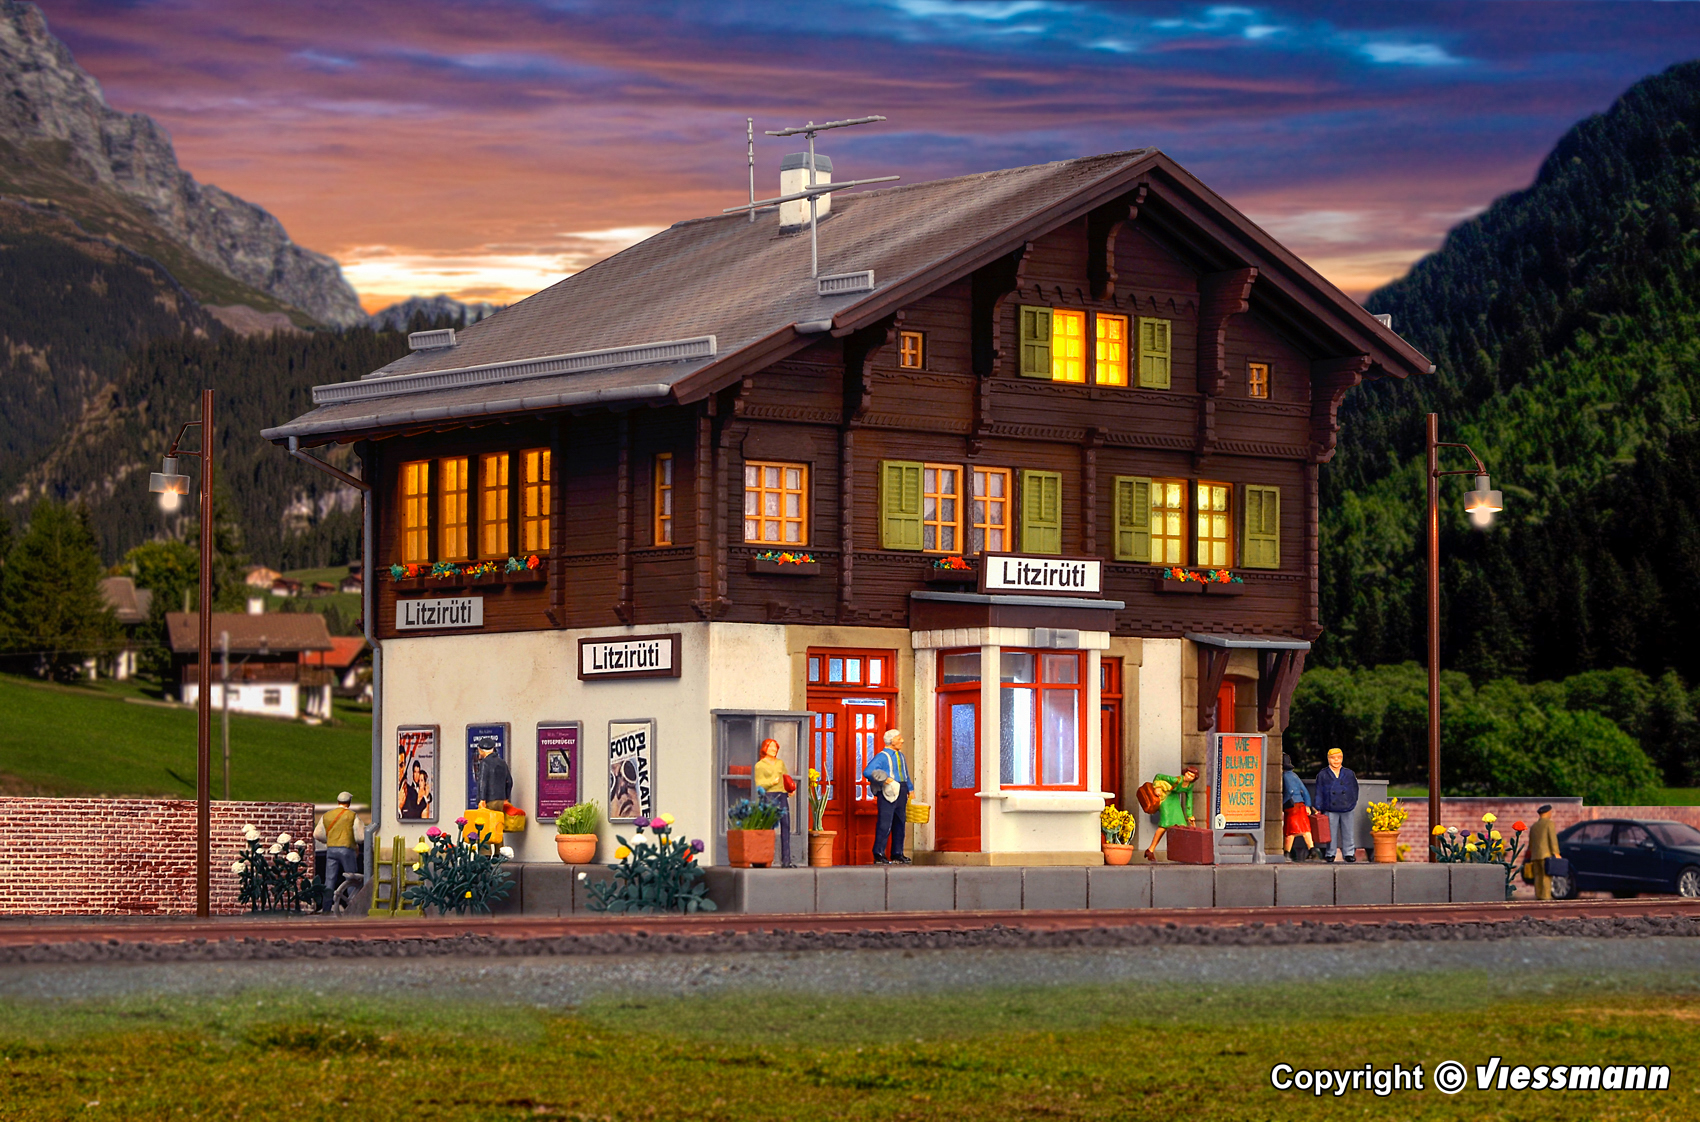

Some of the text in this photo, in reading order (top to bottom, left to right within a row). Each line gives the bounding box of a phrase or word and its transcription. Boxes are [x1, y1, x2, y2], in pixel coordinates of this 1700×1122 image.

[1003, 561, 1085, 587] Litzirüti
[405, 600, 472, 625] Litzirüti
[592, 643, 659, 670] Litzirüti
[611, 735, 635, 758] FOTO
[1235, 738, 1250, 751] WIE
[1226, 756, 1258, 769] BLUMEN
[635, 732, 650, 818] PLAKATE
[1229, 773, 1255, 787] IN DER
[1228, 789, 1255, 805] WÜSTE
